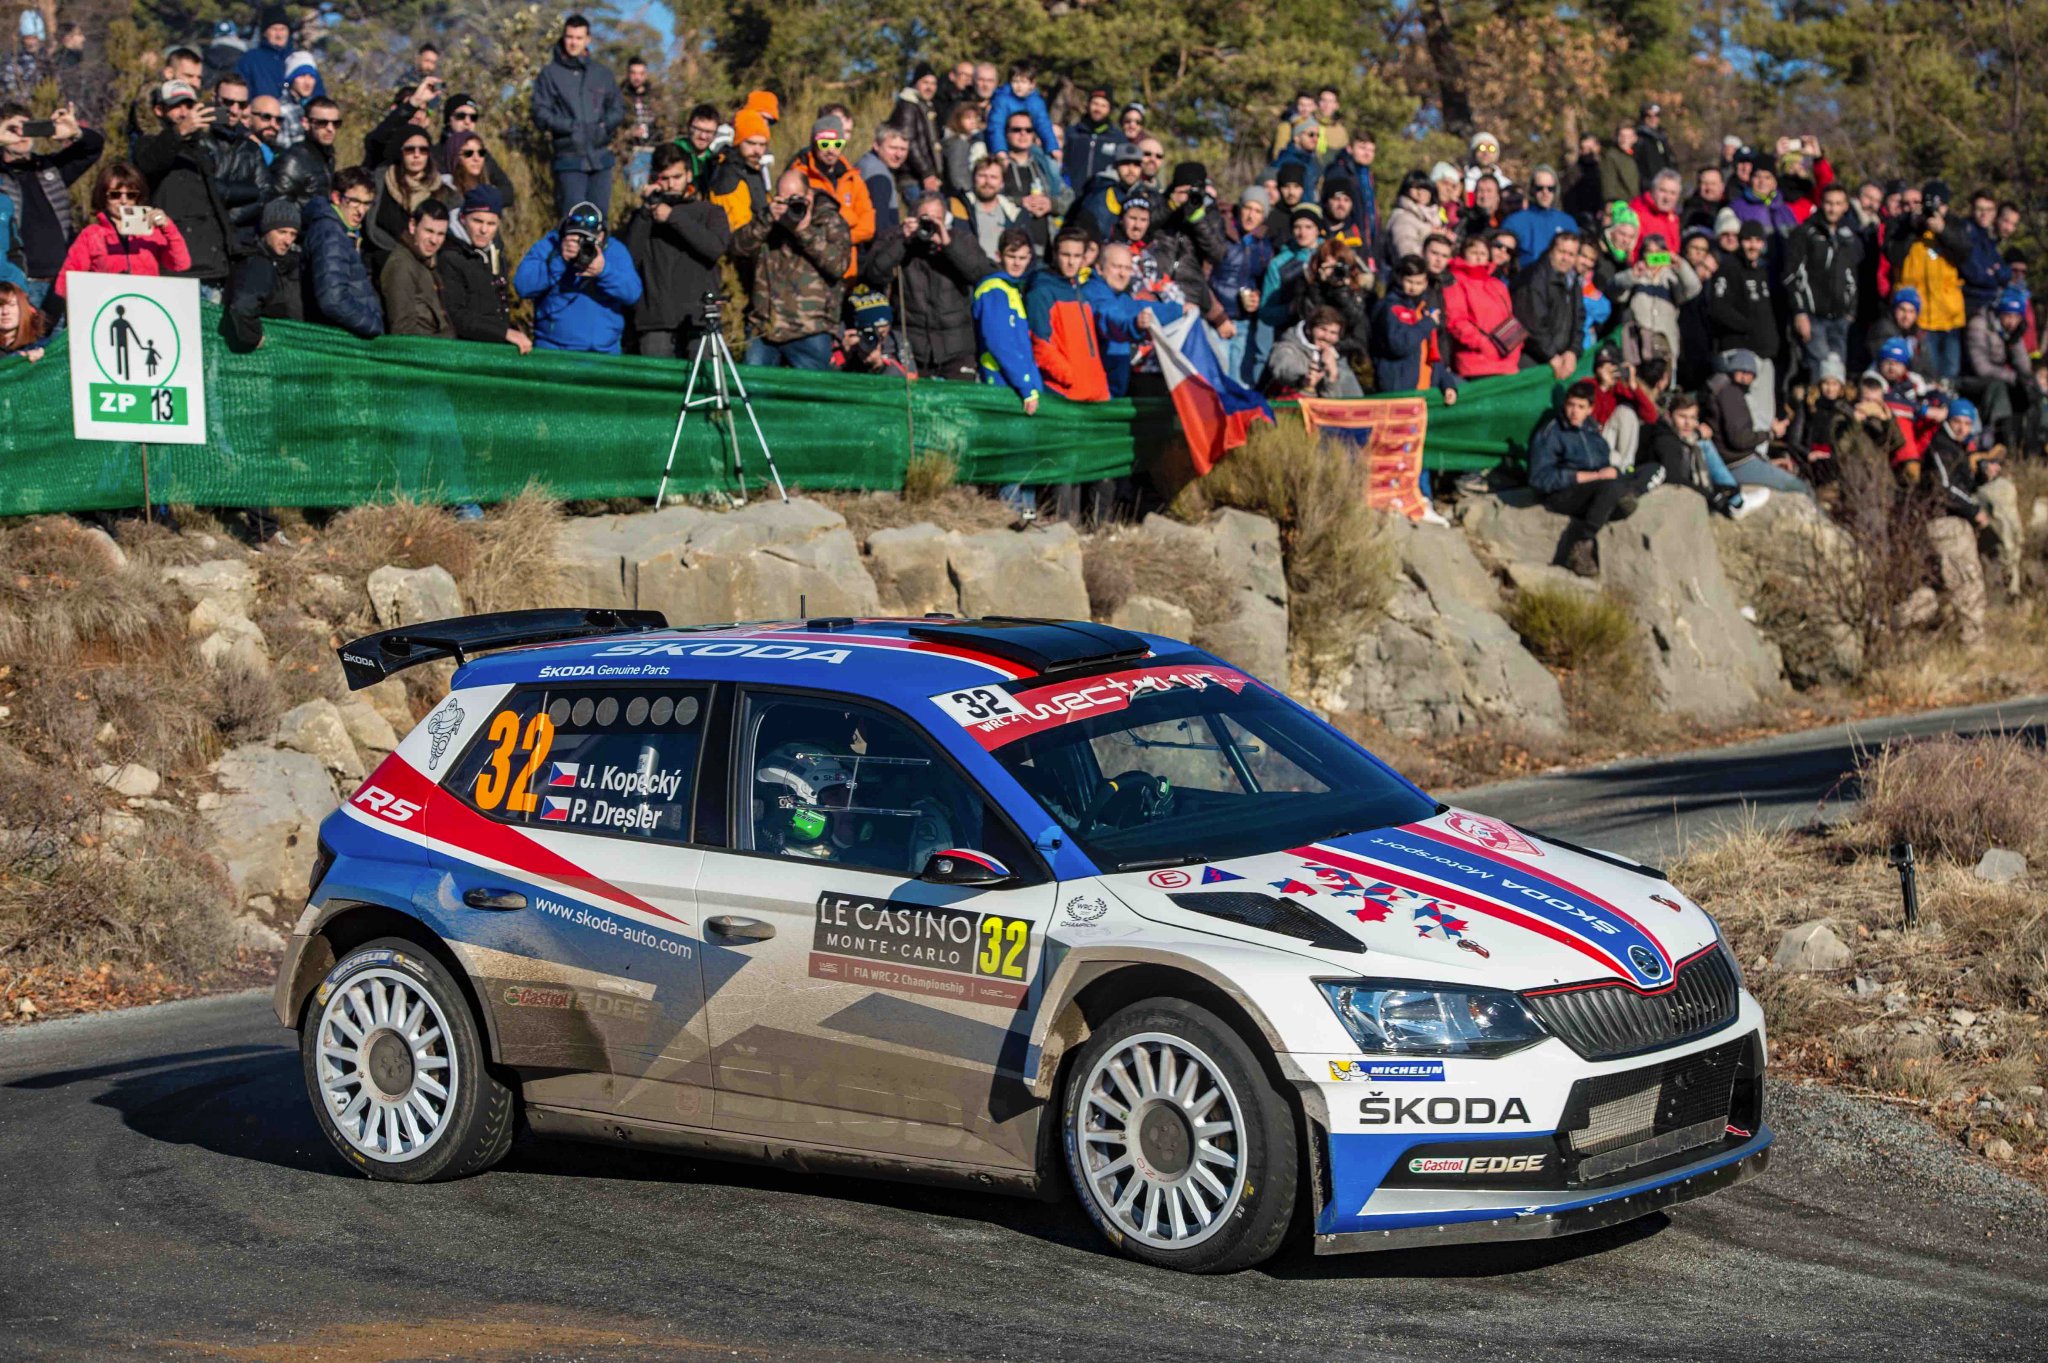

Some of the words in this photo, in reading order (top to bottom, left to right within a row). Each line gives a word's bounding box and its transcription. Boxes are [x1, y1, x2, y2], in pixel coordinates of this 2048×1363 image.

[99, 391, 137, 413] ZP
[151, 388, 174, 421] 13
[343, 652, 375, 668] ŠKODA
[592, 642, 853, 664] ŠKODA
[538, 664, 596, 678] ŠKODA
[597, 664, 641, 677] Genuine
[642, 664, 671, 677] Parts
[951, 689, 1013, 719] 32
[977, 716, 1011, 733] WRC
[474, 710, 555, 813] 32
[580, 764, 596, 789] J.
[600, 765, 682, 801] Kopecký
[354, 785, 423, 822] R5
[571, 798, 586, 823] P.
[591, 800, 663, 830] Dresler
[1370, 837, 1495, 879] Motorsport
[1156, 872, 1183, 886] E
[820, 897, 850, 927] LE
[855, 903, 972, 944] CASINO
[1500, 878, 1622, 936] ŠKODA
[535, 897, 693, 959] www.skoda-auto.com
[979, 916, 1029, 978] 32
[853, 967, 869, 979] FIA
[870, 969, 892, 983] WRC
[892, 972, 900, 984] 2
[901, 973, 965, 995] Championship
[520, 988, 569, 1007] Castrol
[1370, 1065, 1443, 1075] MICHELIN
[1359, 1091, 1531, 1125] ŠKODA
[1423, 1158, 1464, 1172] Castrol
[1467, 1153, 1547, 1174] EDGE
